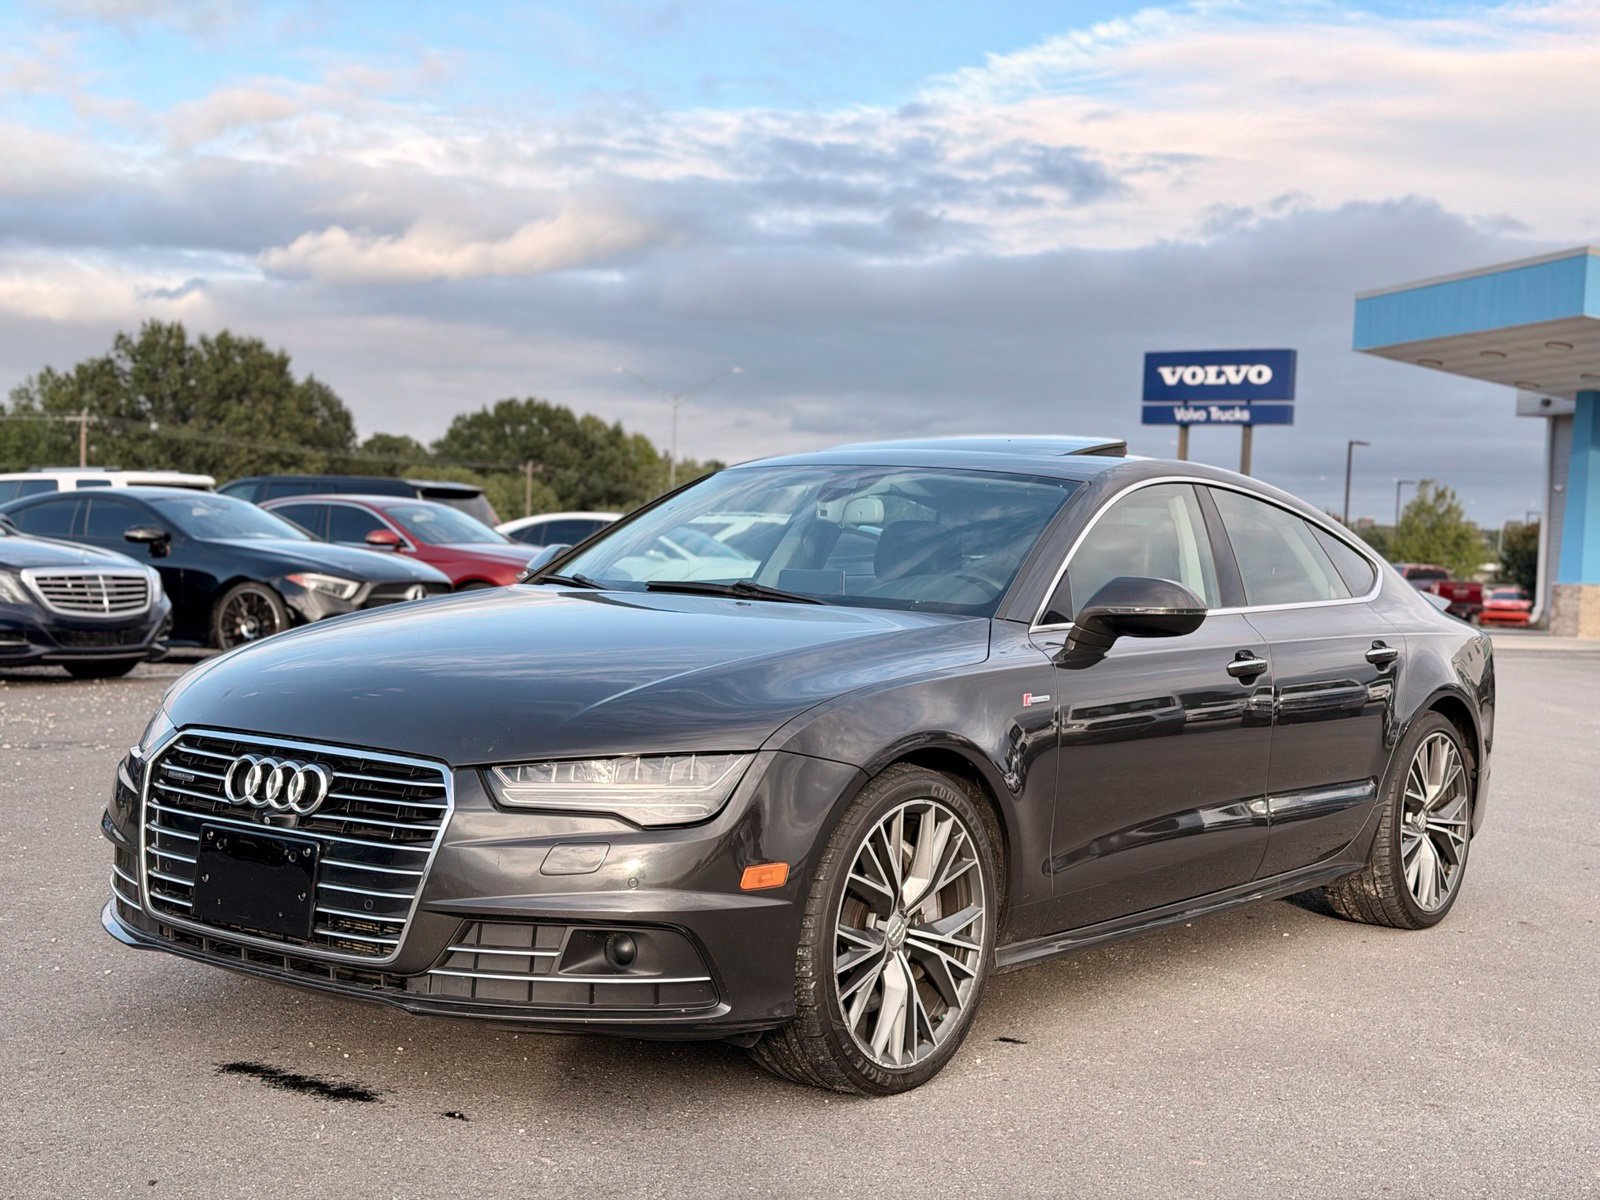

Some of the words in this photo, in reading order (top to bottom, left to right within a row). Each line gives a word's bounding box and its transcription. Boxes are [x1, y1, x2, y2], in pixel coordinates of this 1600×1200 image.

[1157, 364, 1273, 386] VOLVO
[1173, 406, 1207, 421] Volvo
[1208, 406, 1251, 421] Trucks
[853, 1057, 893, 1086] EAGLE
